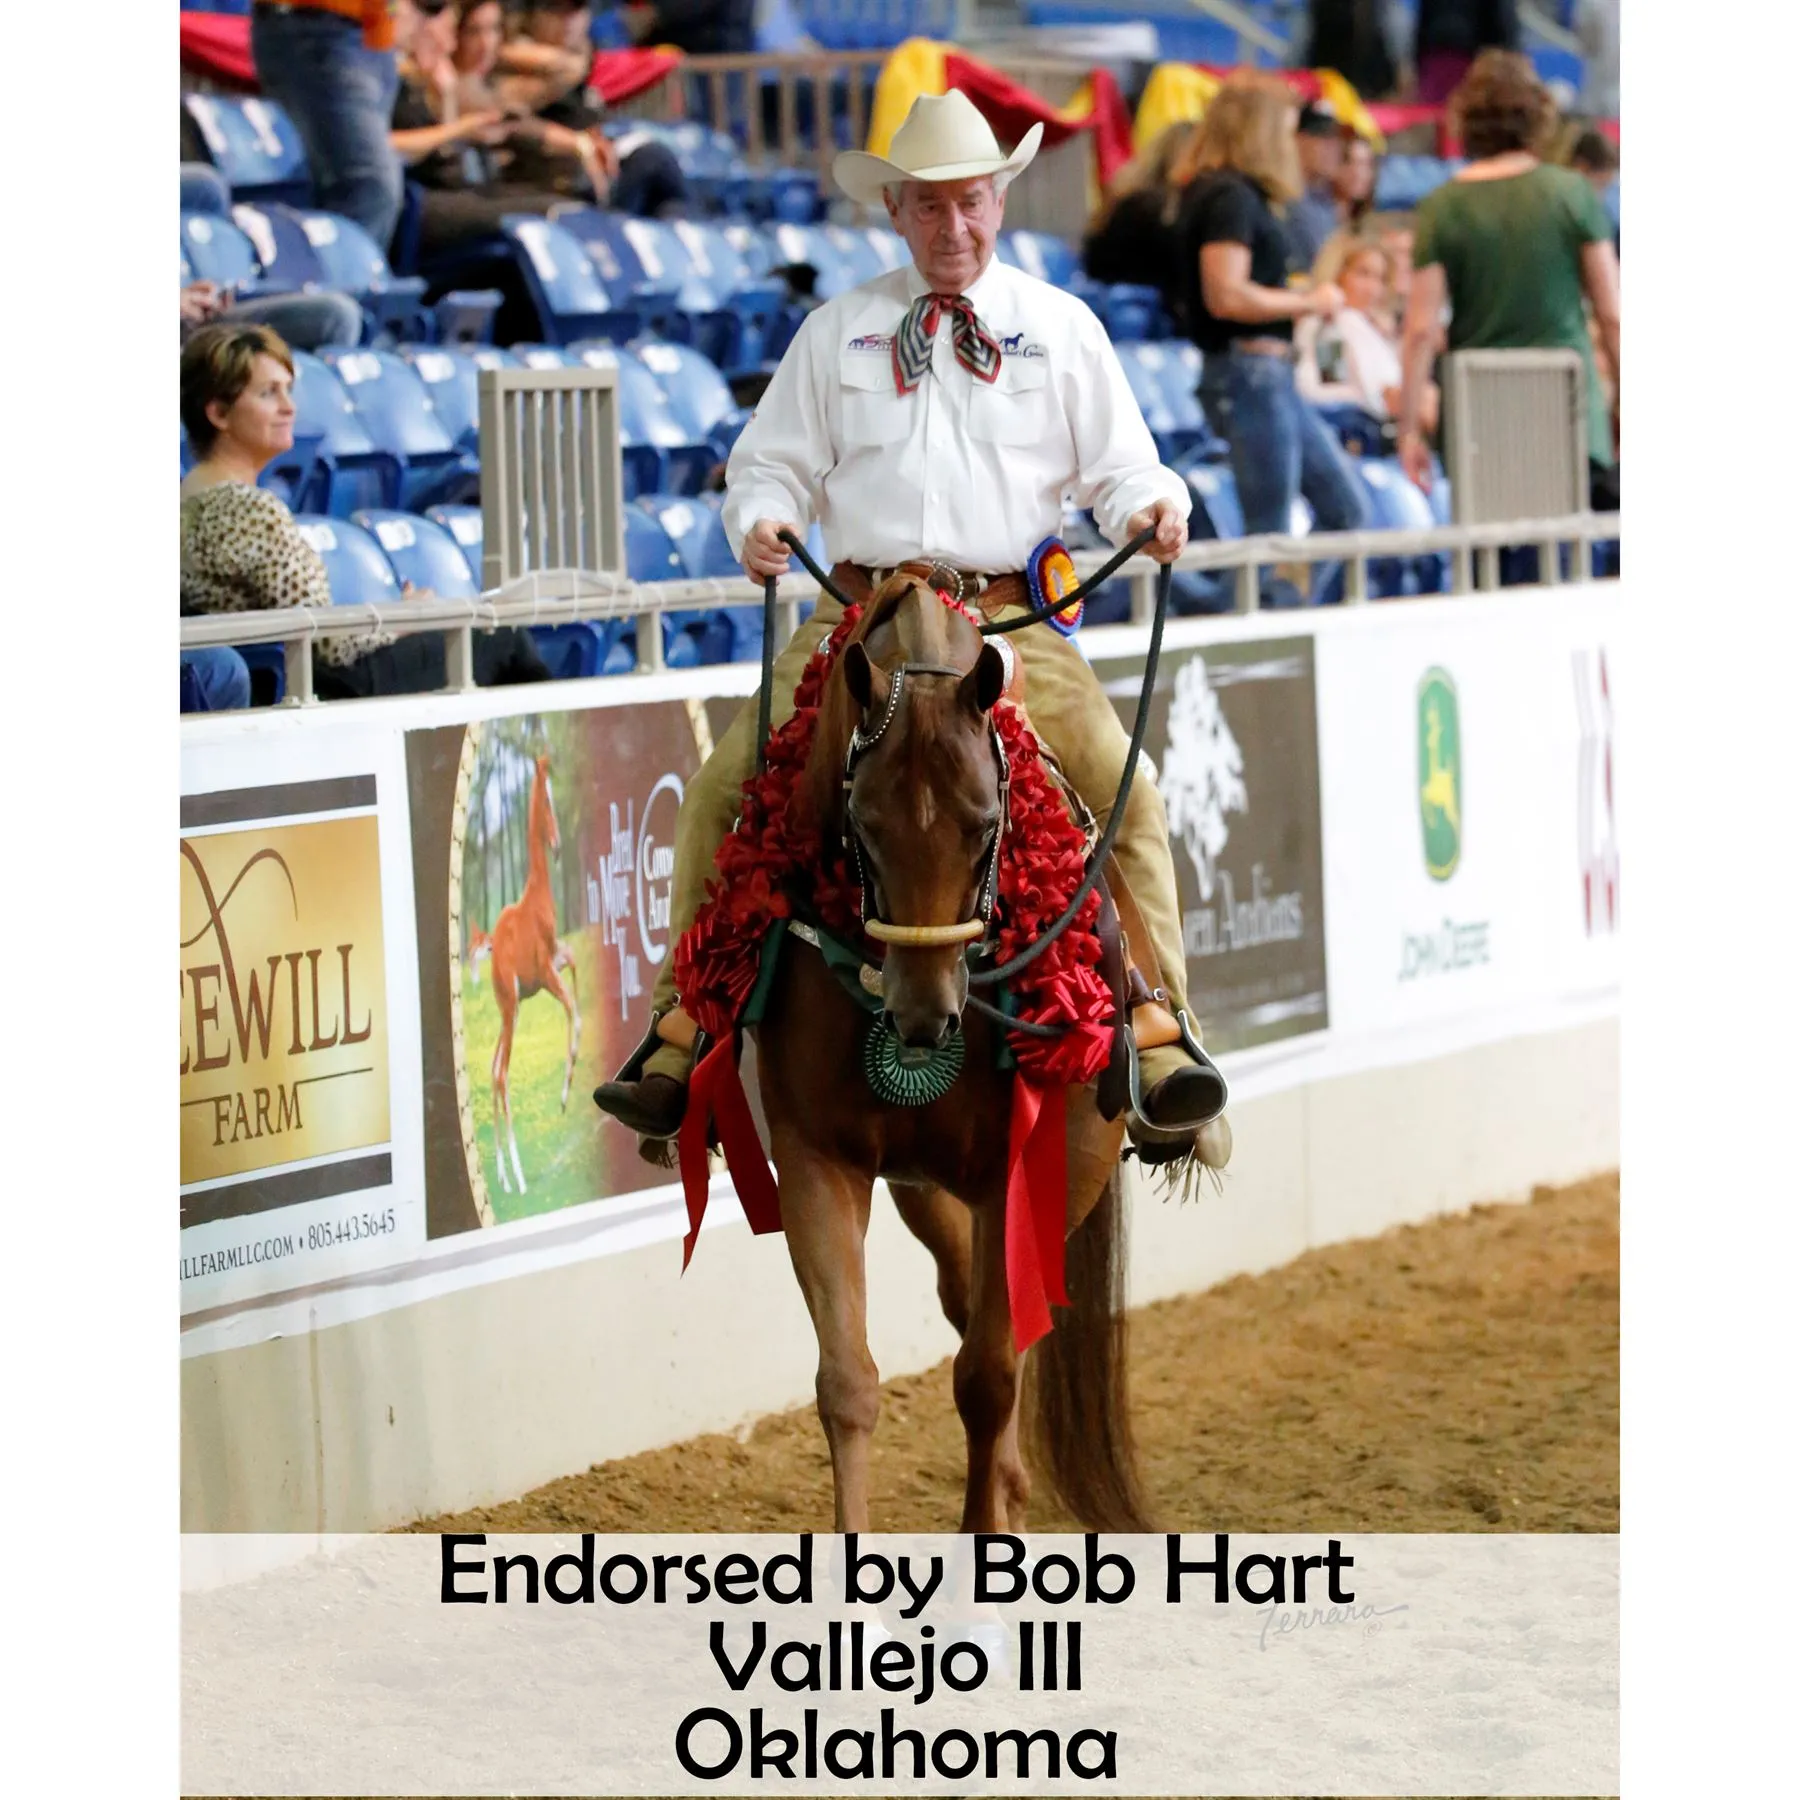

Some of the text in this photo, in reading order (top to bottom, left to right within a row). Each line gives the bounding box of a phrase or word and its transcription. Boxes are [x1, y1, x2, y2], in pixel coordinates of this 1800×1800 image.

[180, 943, 372, 1076] EWILL
[213, 1083, 304, 1147] FARM
[308, 1207, 396, 1250] 805.443.5645
